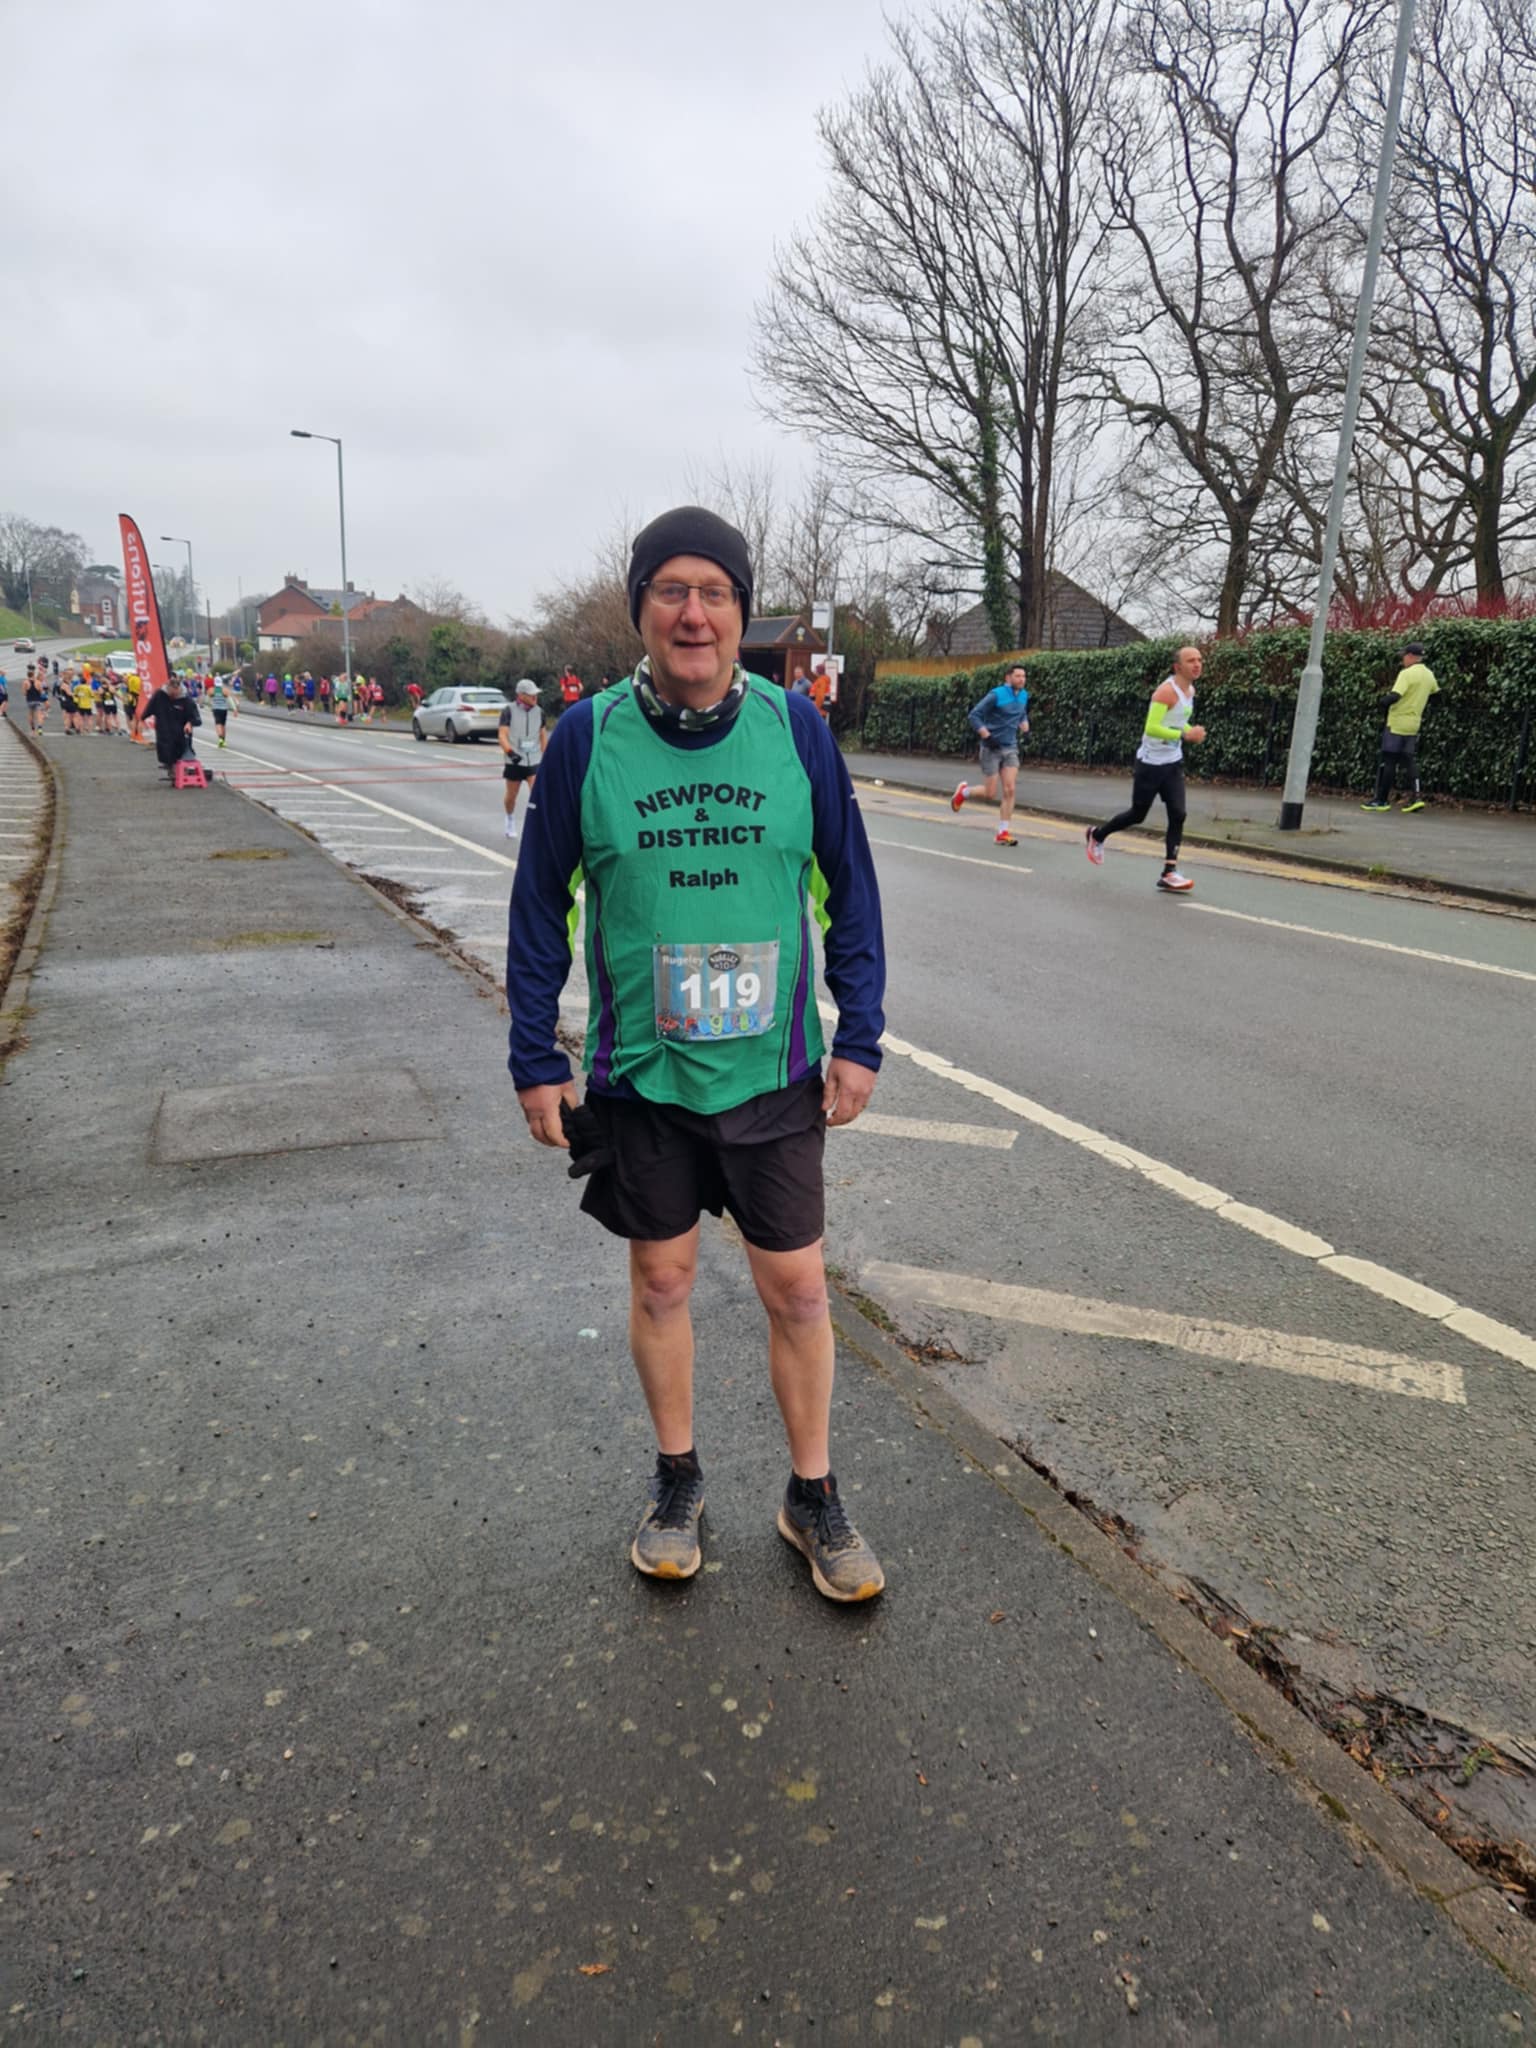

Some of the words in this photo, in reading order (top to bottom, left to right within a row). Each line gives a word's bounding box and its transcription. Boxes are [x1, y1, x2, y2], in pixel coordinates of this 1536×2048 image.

[634, 783, 766, 818] NEWPORT
[694, 807, 710, 822] &
[638, 825, 765, 849] DISTRICT
[669, 868, 739, 890] Ralph
[680, 972, 761, 1009] 119
